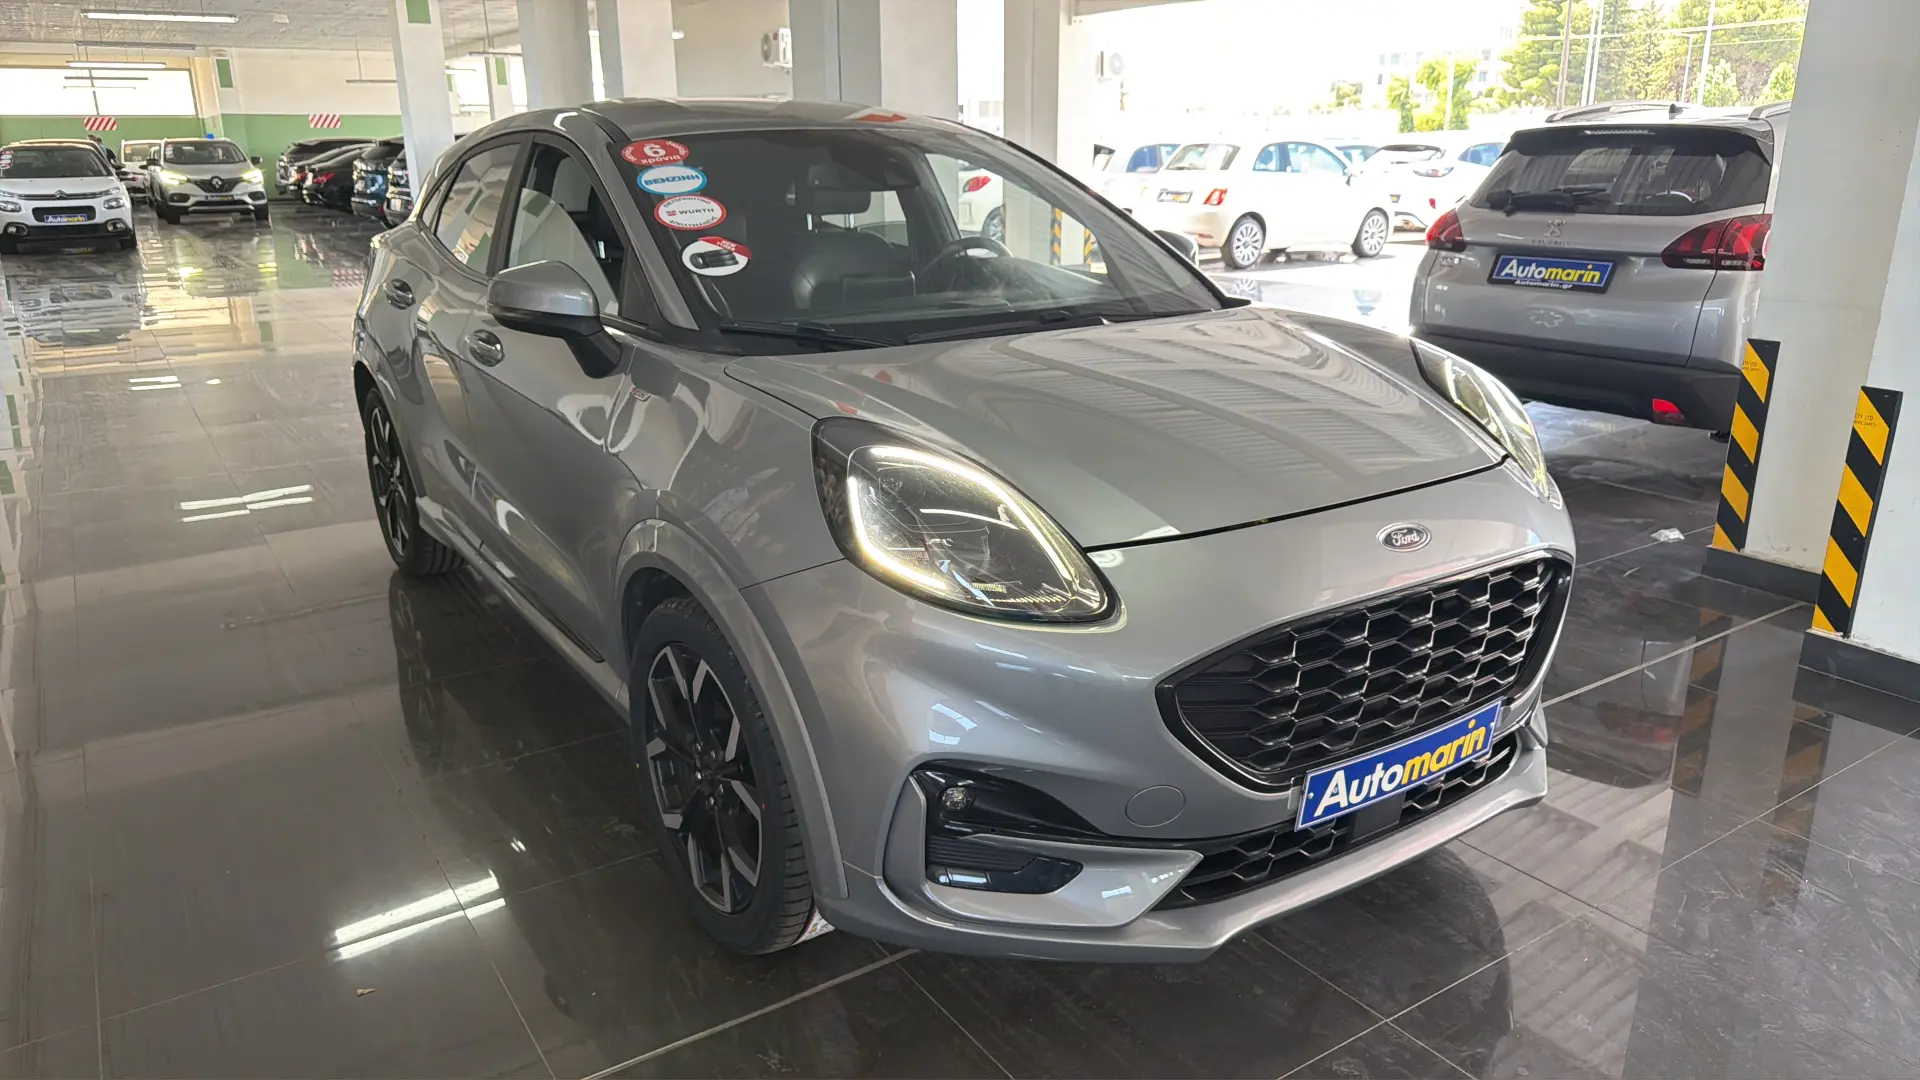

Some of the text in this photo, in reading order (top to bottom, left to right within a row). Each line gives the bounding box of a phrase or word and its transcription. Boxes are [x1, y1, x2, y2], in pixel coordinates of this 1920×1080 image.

[643, 143, 666, 157] 6
[1501, 258, 1601, 284] Automarin
[1391, 529, 1420, 546] Ford
[1313, 718, 1487, 818] Automarin
